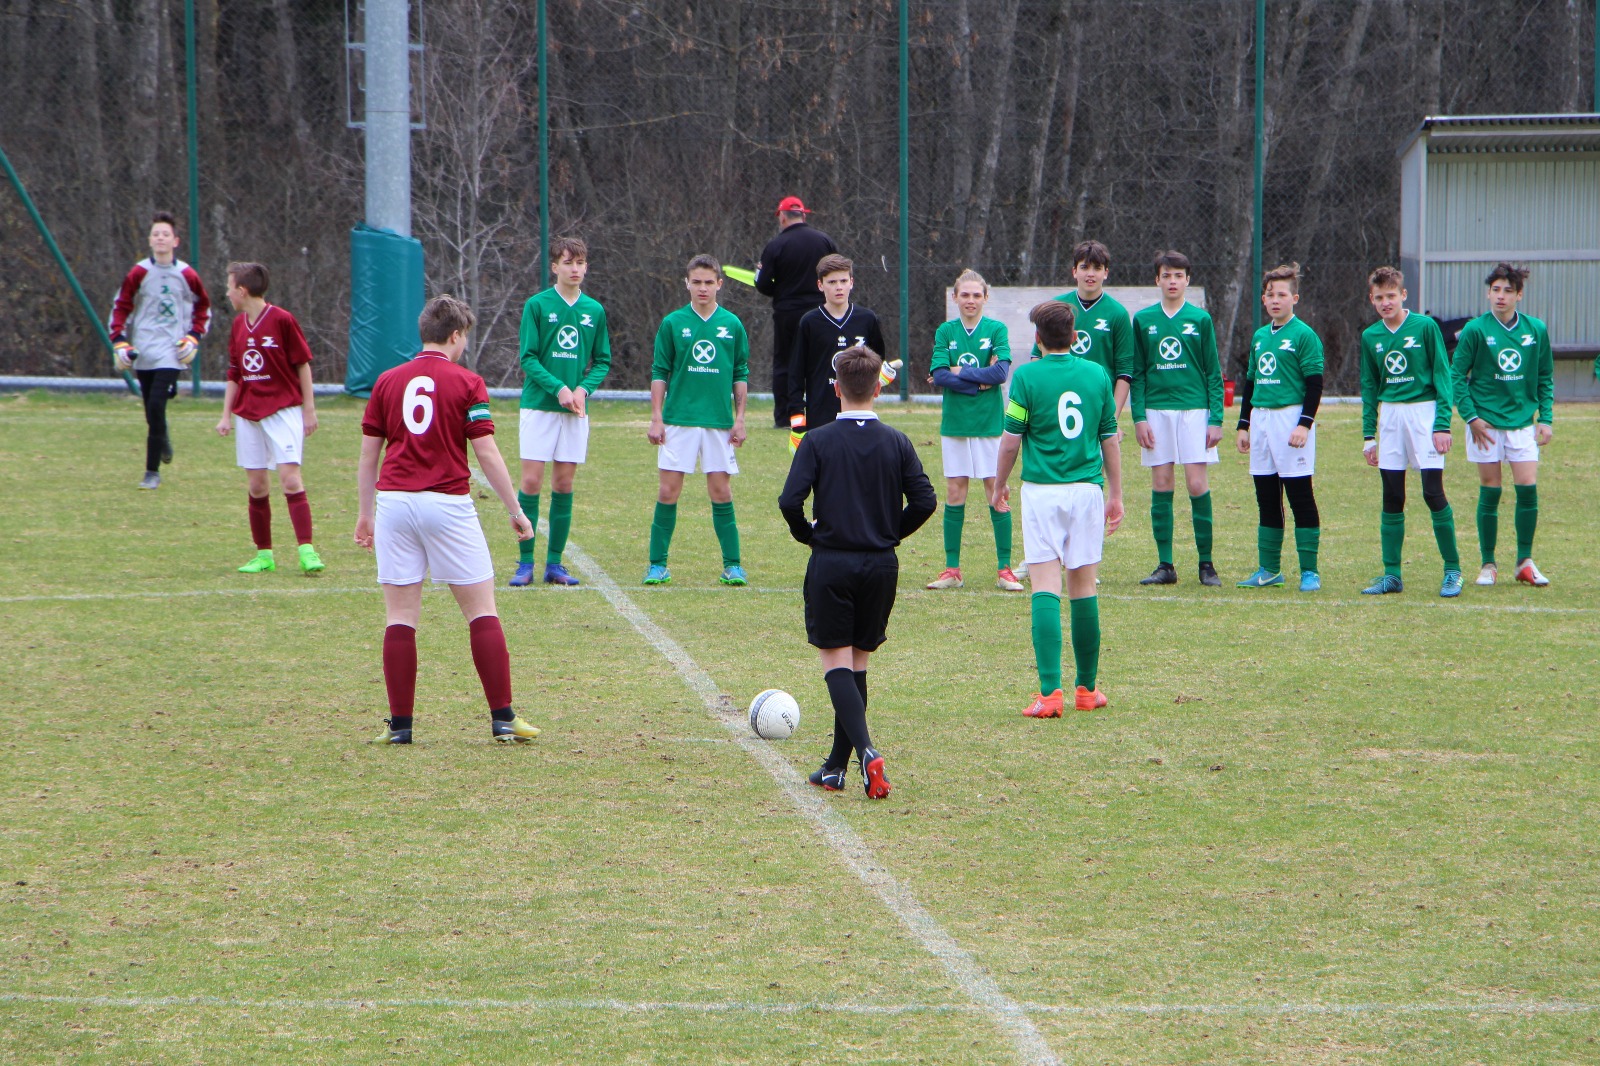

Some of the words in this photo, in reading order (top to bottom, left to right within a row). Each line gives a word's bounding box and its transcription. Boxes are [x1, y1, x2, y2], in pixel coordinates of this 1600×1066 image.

[688, 365, 719, 374] Raiffeisen
[402, 375, 435, 435] 6
[1057, 391, 1084, 439] 6
